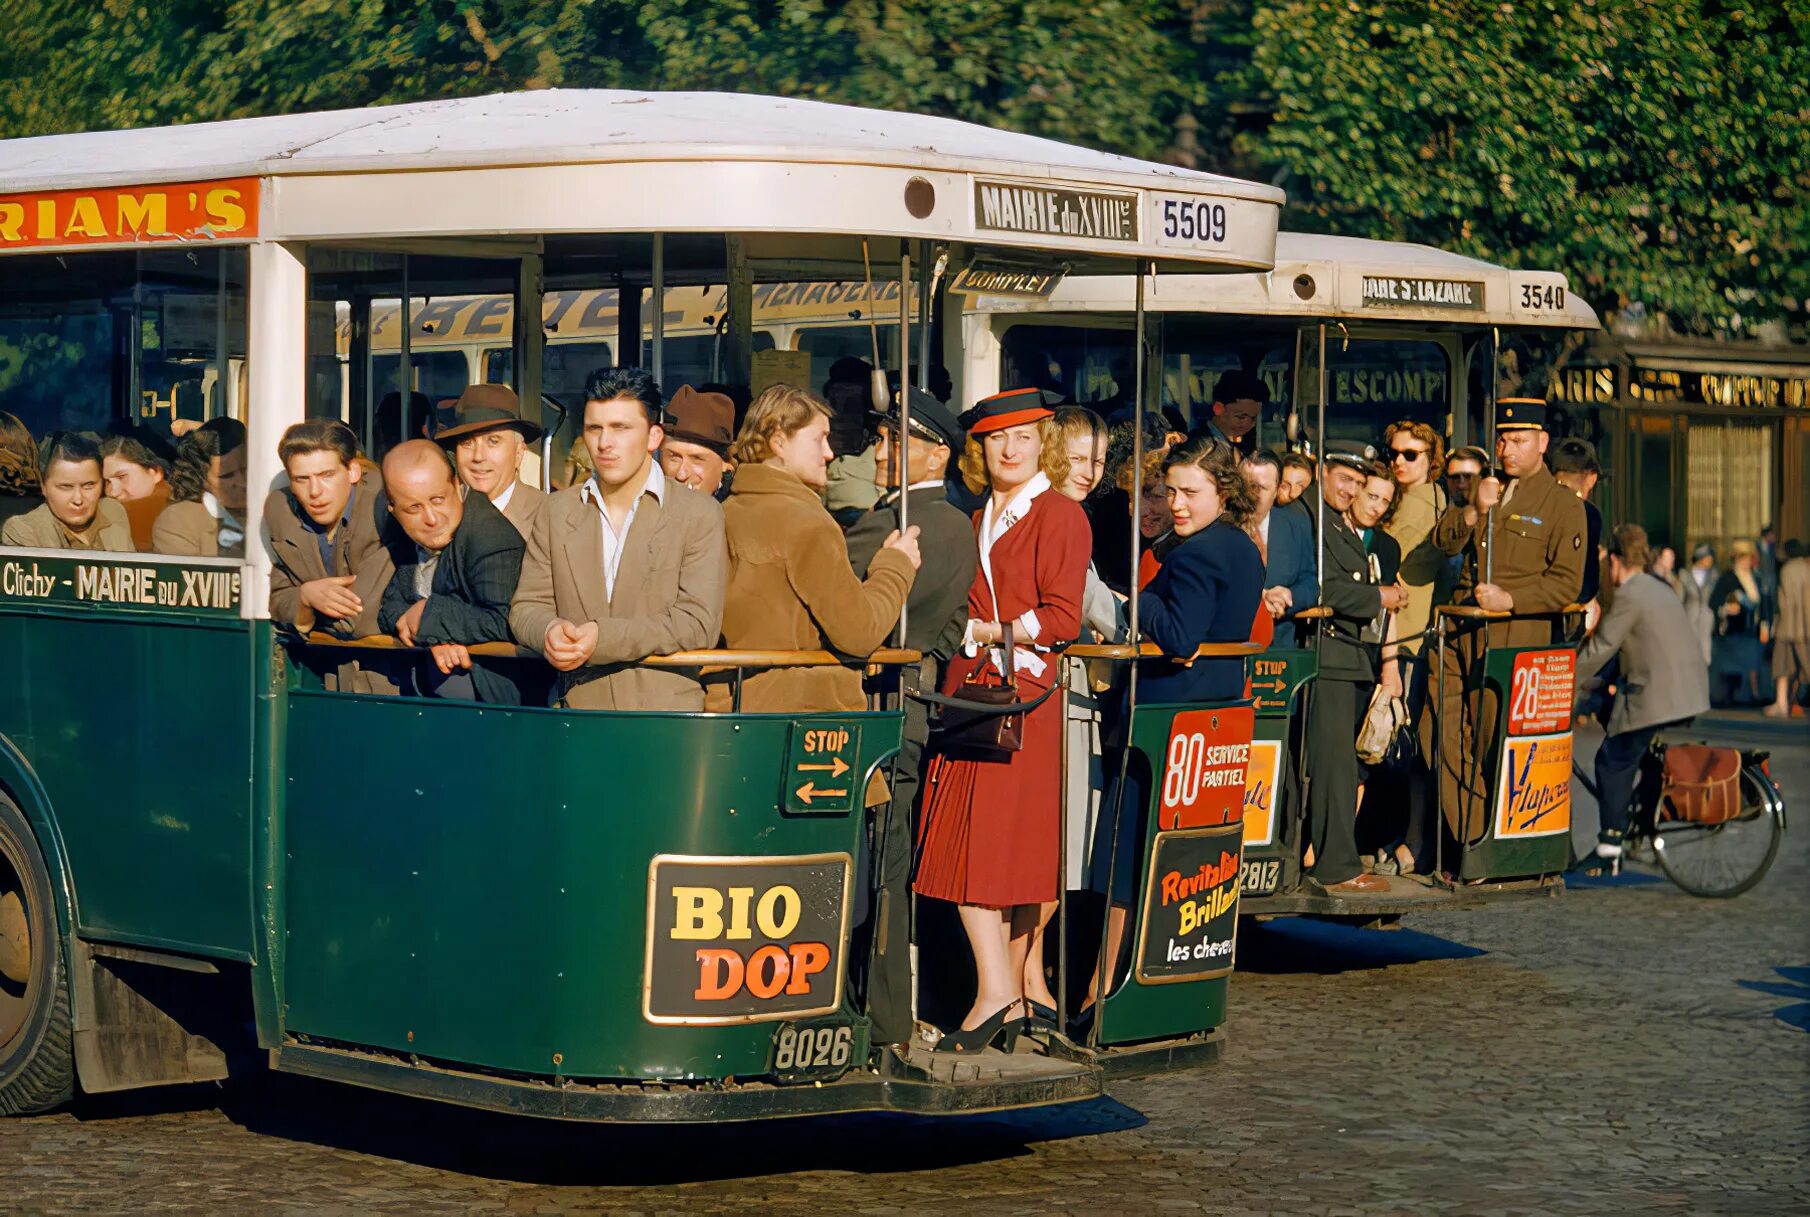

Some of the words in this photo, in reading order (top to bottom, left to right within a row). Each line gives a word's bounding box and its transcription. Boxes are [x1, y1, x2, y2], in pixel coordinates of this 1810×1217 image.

[981, 185, 1060, 232] MAIRIE
[1061, 199, 1079, 234] du
[1164, 200, 1227, 242] 5509
[1521, 285, 1565, 310] 3540
[3, 562, 56, 597] Clichy
[78, 565, 157, 604] MAIRIE
[158, 581, 178, 606] DU
[1255, 660, 1287, 676] STOP
[1512, 667, 1540, 722] 28
[804, 730, 849, 753] STOP
[1205, 744, 1249, 766] SERVICE
[1164, 732, 1205, 807] 80
[1201, 768, 1245, 788] PARTIEL
[670, 885, 802, 940] BIO
[694, 941, 831, 1001] DOP
[1167, 938, 1190, 962] les
[775, 1026, 852, 1070] 8026
